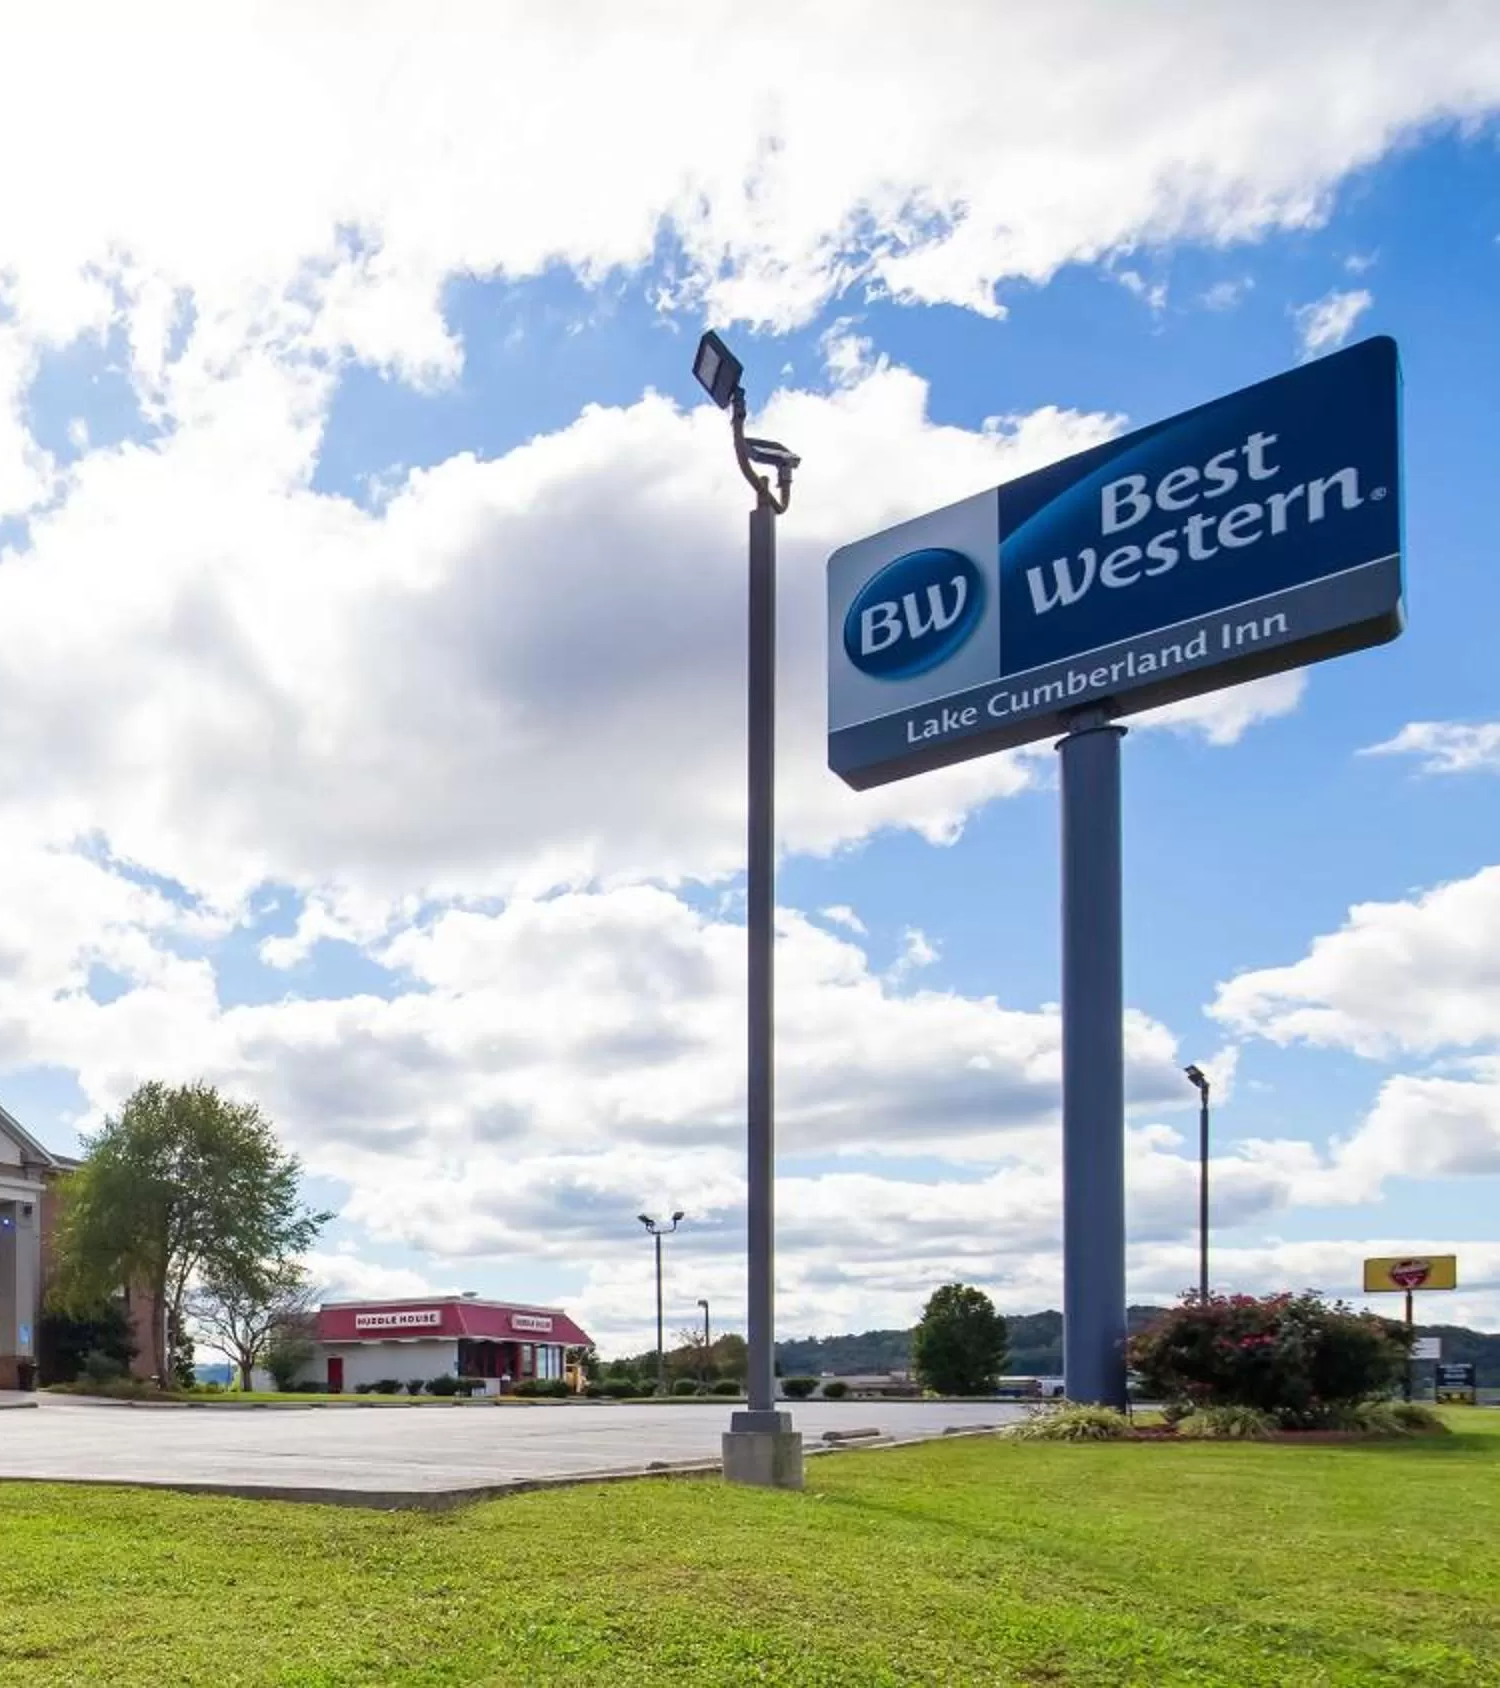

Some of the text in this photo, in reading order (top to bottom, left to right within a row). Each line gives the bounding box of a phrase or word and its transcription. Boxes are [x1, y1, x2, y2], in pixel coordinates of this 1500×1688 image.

[1101, 432, 1280, 537] Best
[1026, 466, 1365, 616] Western
[860, 575, 968, 656] BW
[906, 611, 1289, 743] Lake Cumberland Inn
[400, 1313, 437, 1323] HOUSE
